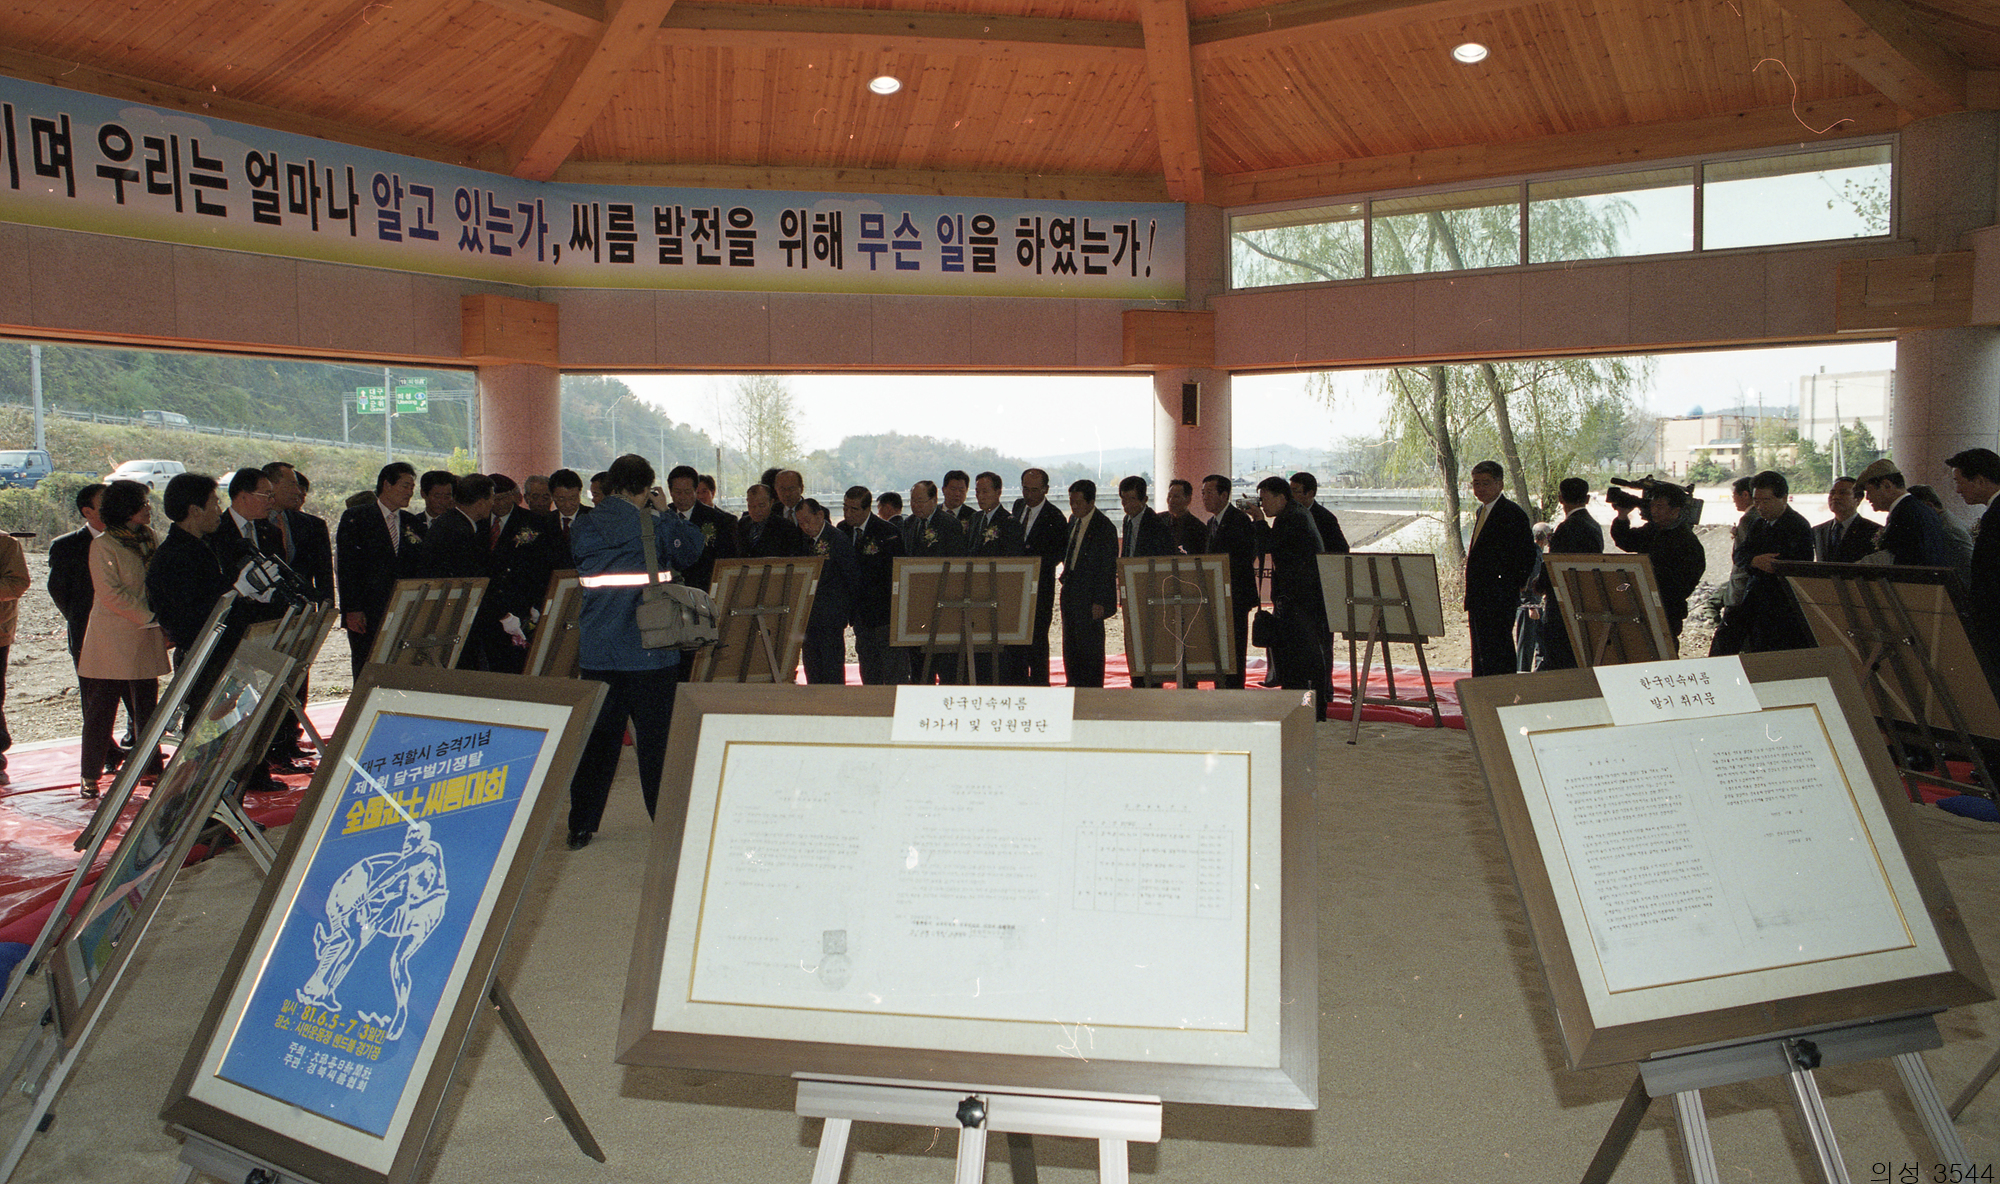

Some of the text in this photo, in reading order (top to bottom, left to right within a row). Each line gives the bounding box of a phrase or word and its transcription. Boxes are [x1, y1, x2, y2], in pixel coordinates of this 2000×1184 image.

[95, 122, 229, 218] 우리는
[244, 149, 360, 238] 얼마나
[371, 171, 440, 243] 알고
[453, 186, 561, 266] 있는가,
[567, 201, 638, 265] 씨름
[653, 204, 758, 268] 발전을
[778, 208, 844, 271] 위해
[856, 212, 923, 272] 무슨
[935, 212, 1000, 274] 일을
[1013, 216, 1158, 279] 하였는가!
[1639, 671, 1710, 690] 한국민속씨름
[943, 696, 1028, 711] 한국민속씨름
[1649, 691, 1716, 710] 발기 취지문
[919, 717, 1048, 733] 허가서 및 임원명단
[361, 728, 492, 775] 대구 직할시 승격기념
[393, 750, 484, 787] 달구벌기쟁탈
[281, 999, 299, 1015] 일시
[275, 1015, 291, 1030] 장소
[294, 1021, 334, 1046] 시민운동장
[355, 1041, 382, 1061] 경기장
